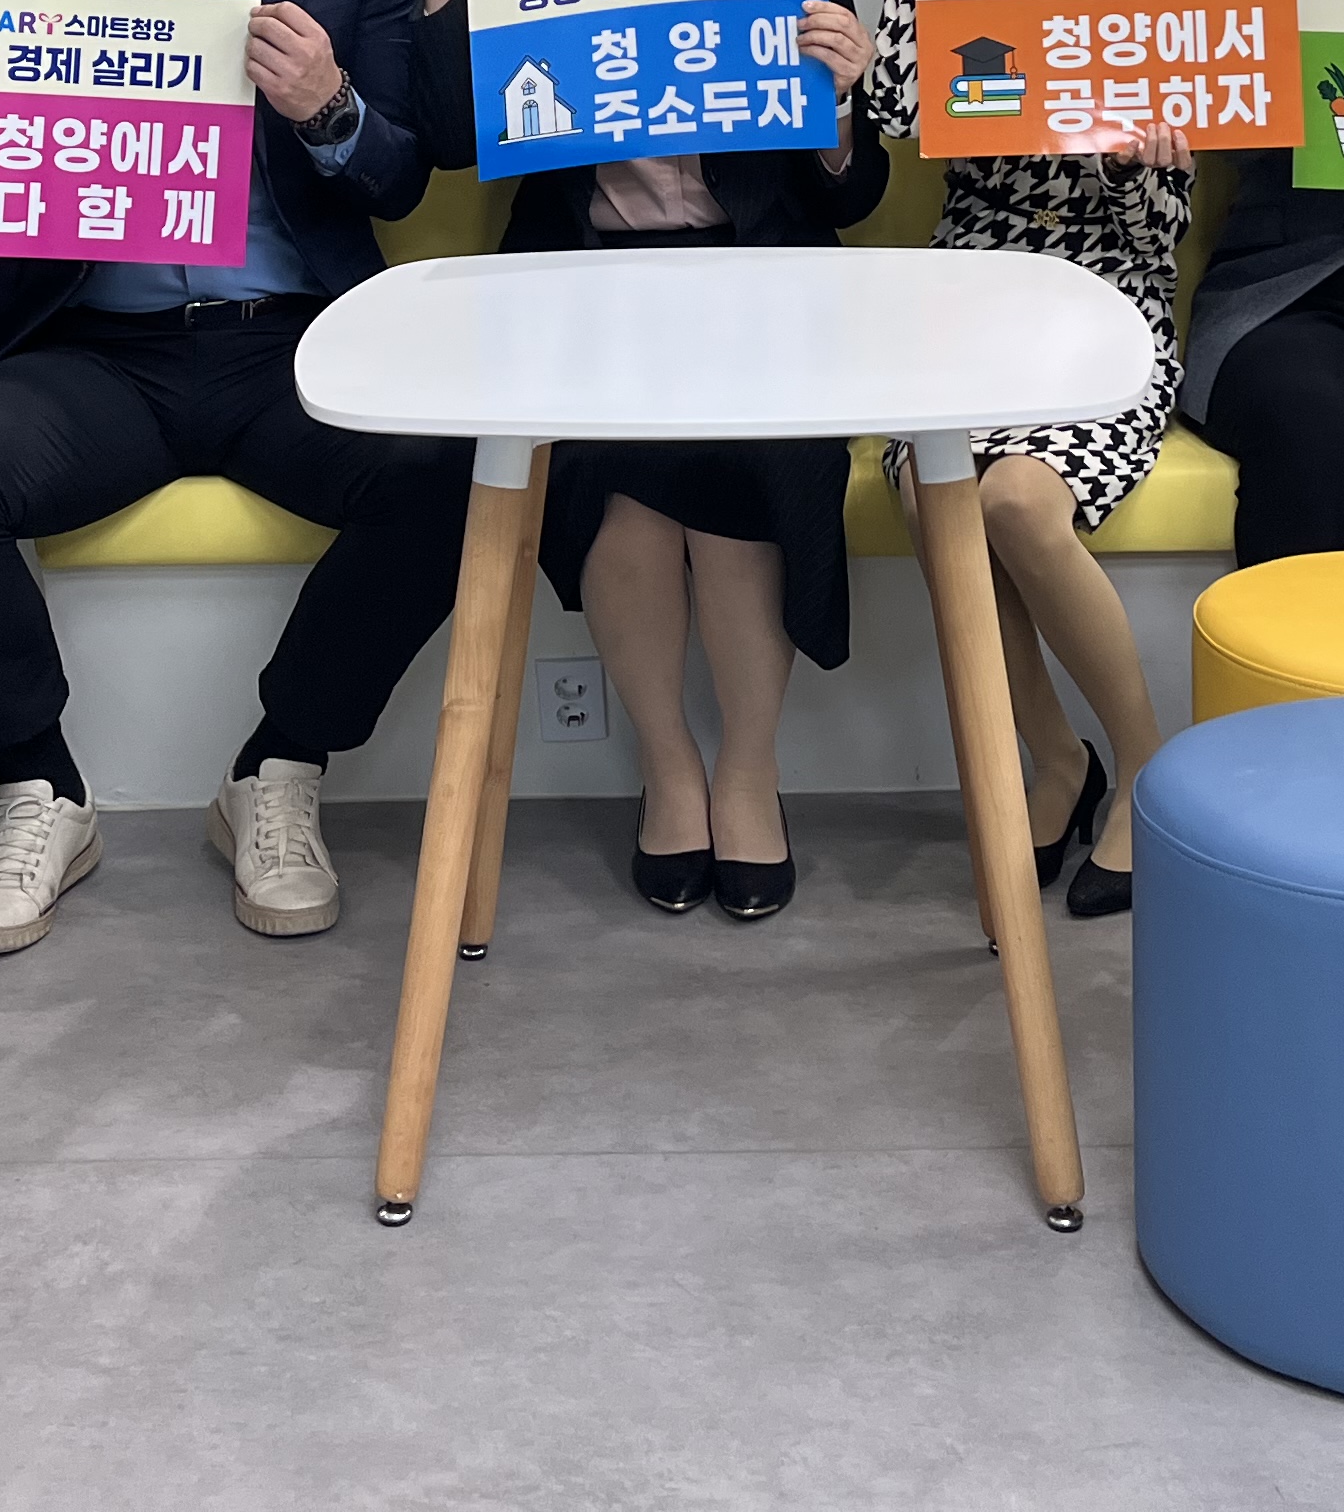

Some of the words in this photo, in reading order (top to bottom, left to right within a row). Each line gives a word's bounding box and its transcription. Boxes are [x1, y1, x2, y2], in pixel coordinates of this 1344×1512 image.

[64, 14, 175, 42] 스마트청양
[1041, 6, 1266, 70] 청양에서
[6, 44, 81, 85] 경제
[92, 49, 203, 92] 살리기
[593, 76, 807, 143] 주소두자
[1043, 72, 1272, 134] 공부하자
